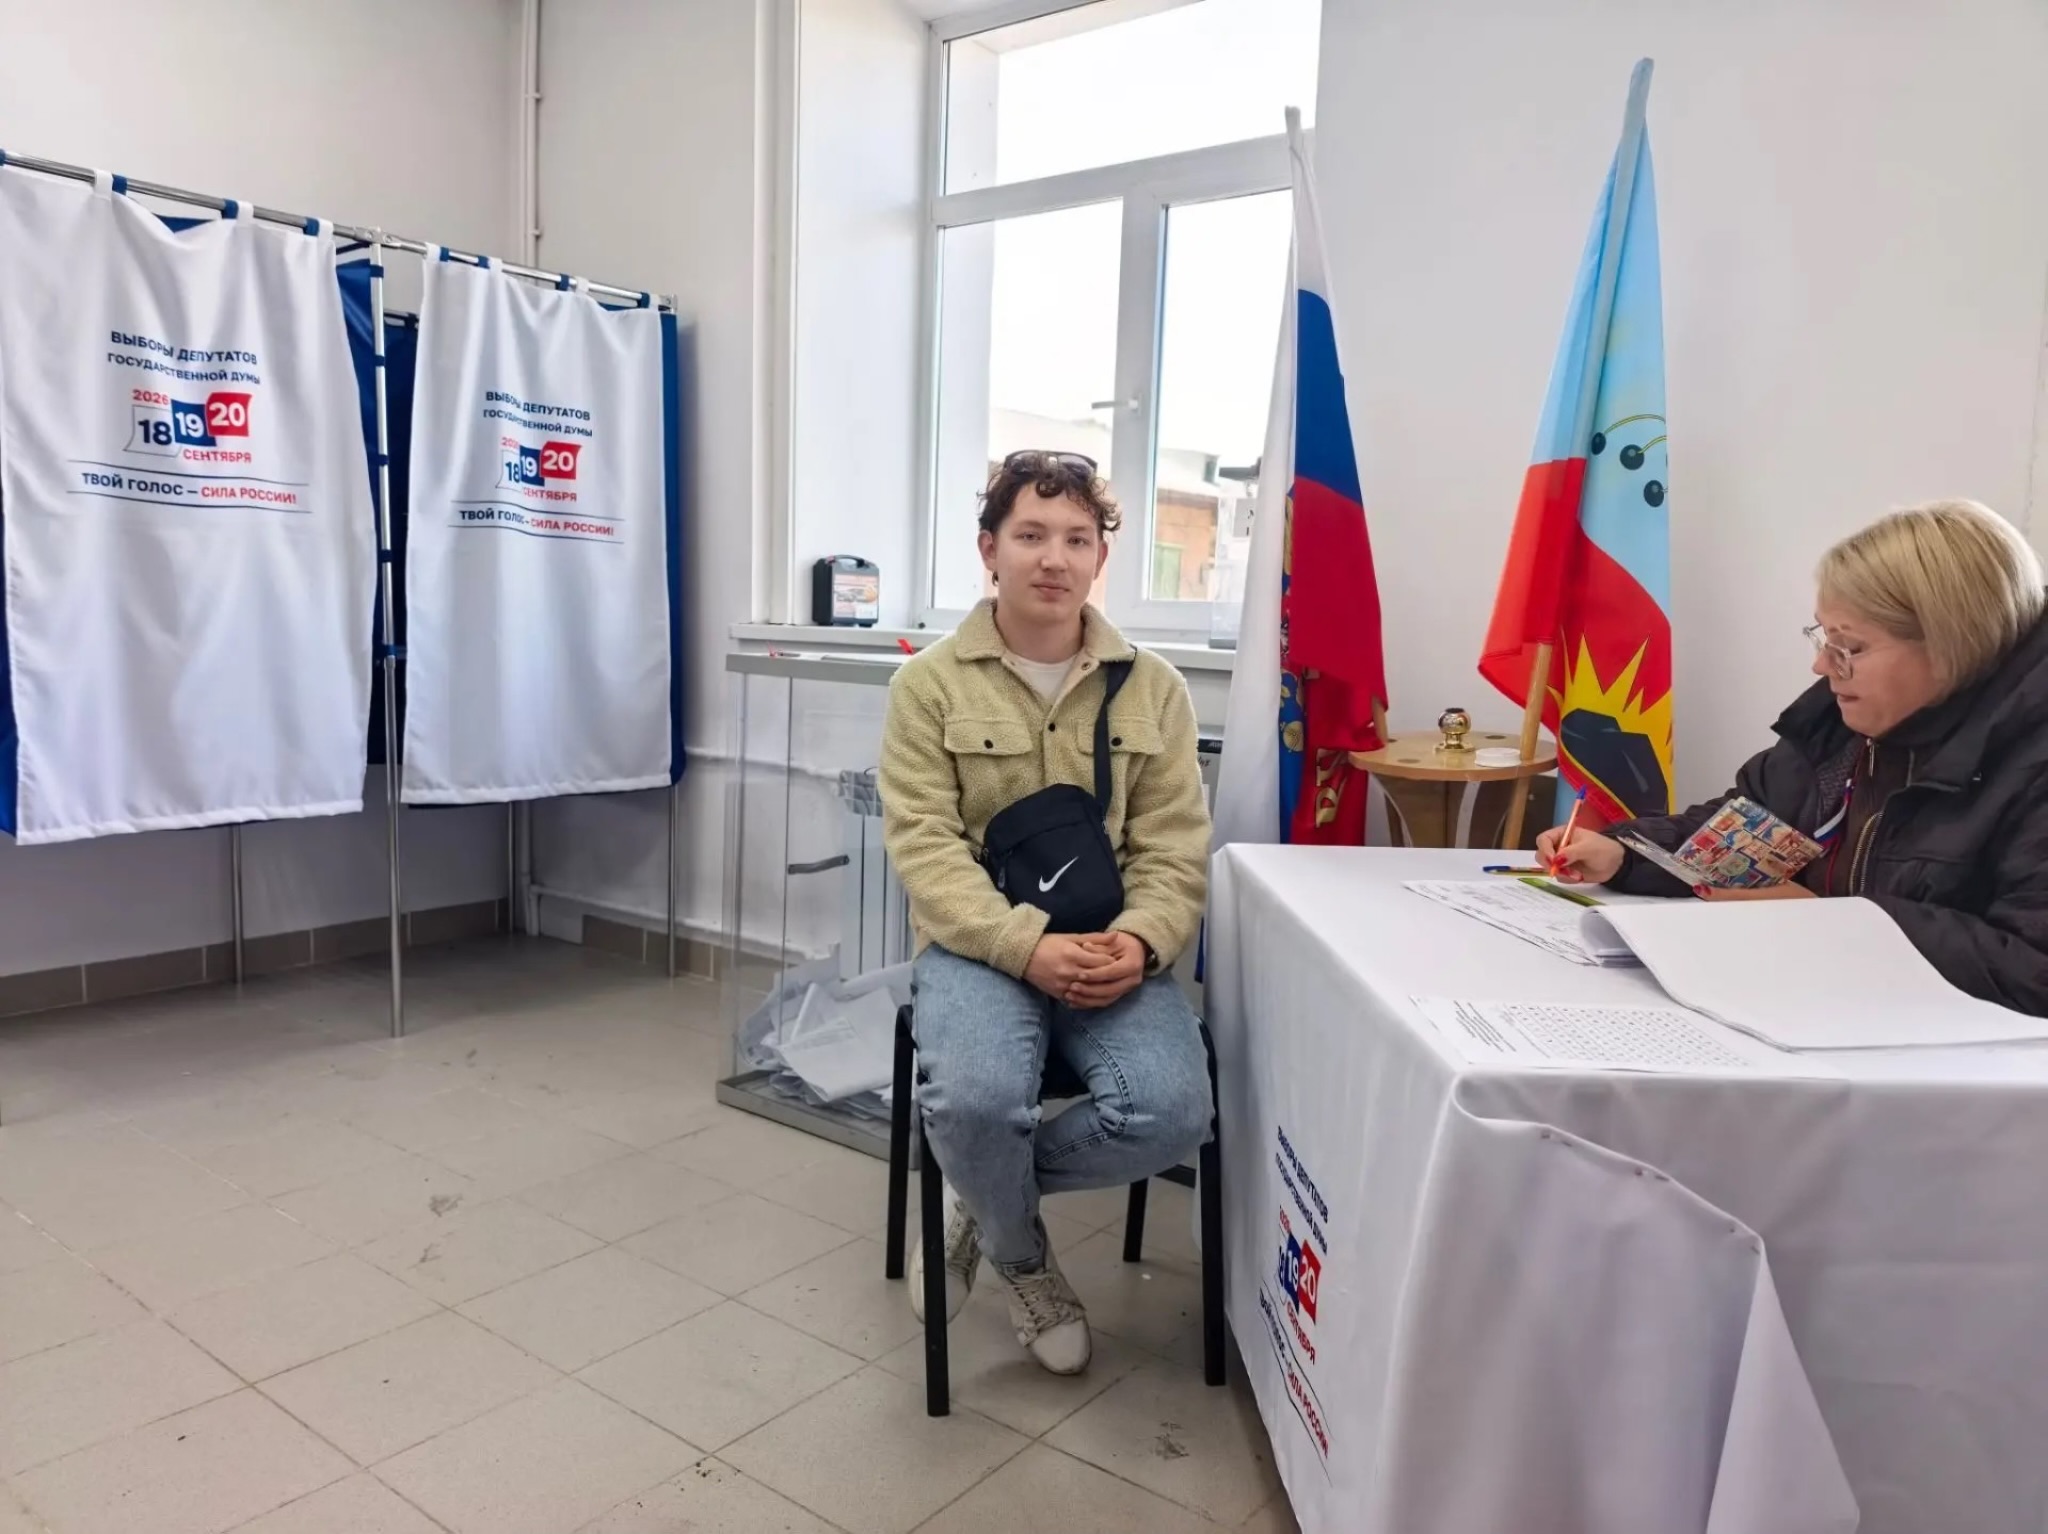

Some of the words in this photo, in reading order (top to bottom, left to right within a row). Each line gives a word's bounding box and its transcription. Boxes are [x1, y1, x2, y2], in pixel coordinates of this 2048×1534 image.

[110, 330, 174, 358] ВЫБОРЫ
[176, 348, 257, 365] ДЕПУТАТОВ
[107, 352, 228, 381] ГОСУДАРСТВЕННОЙ
[230, 371, 261, 385] ДУМЫ
[132, 389, 169, 406] 2026
[522, 402, 591, 421] ДЕПУТАТОВ
[138, 419, 172, 446] 18
[175, 412, 204, 438] 19
[208, 402, 246, 427] 20
[564, 425, 593, 437] ДУМЫ
[183, 449, 252, 463] СЕНТЯБРЯ
[505, 461, 520, 483] 18
[521, 456, 537, 477] 19
[543, 449, 574, 471] 20
[82, 472, 123, 489] ТВОЙ
[128, 479, 183, 496] ГОЛОС
[201, 486, 237, 498] СИЛА
[240, 489, 298, 505] РОССИИ!
[459, 507, 494, 521] ТВОЙ
[531, 518, 560, 530] СИЛА
[563, 522, 615, 537] РОССИИ!
[1300, 1254, 1316, 1304] 20
